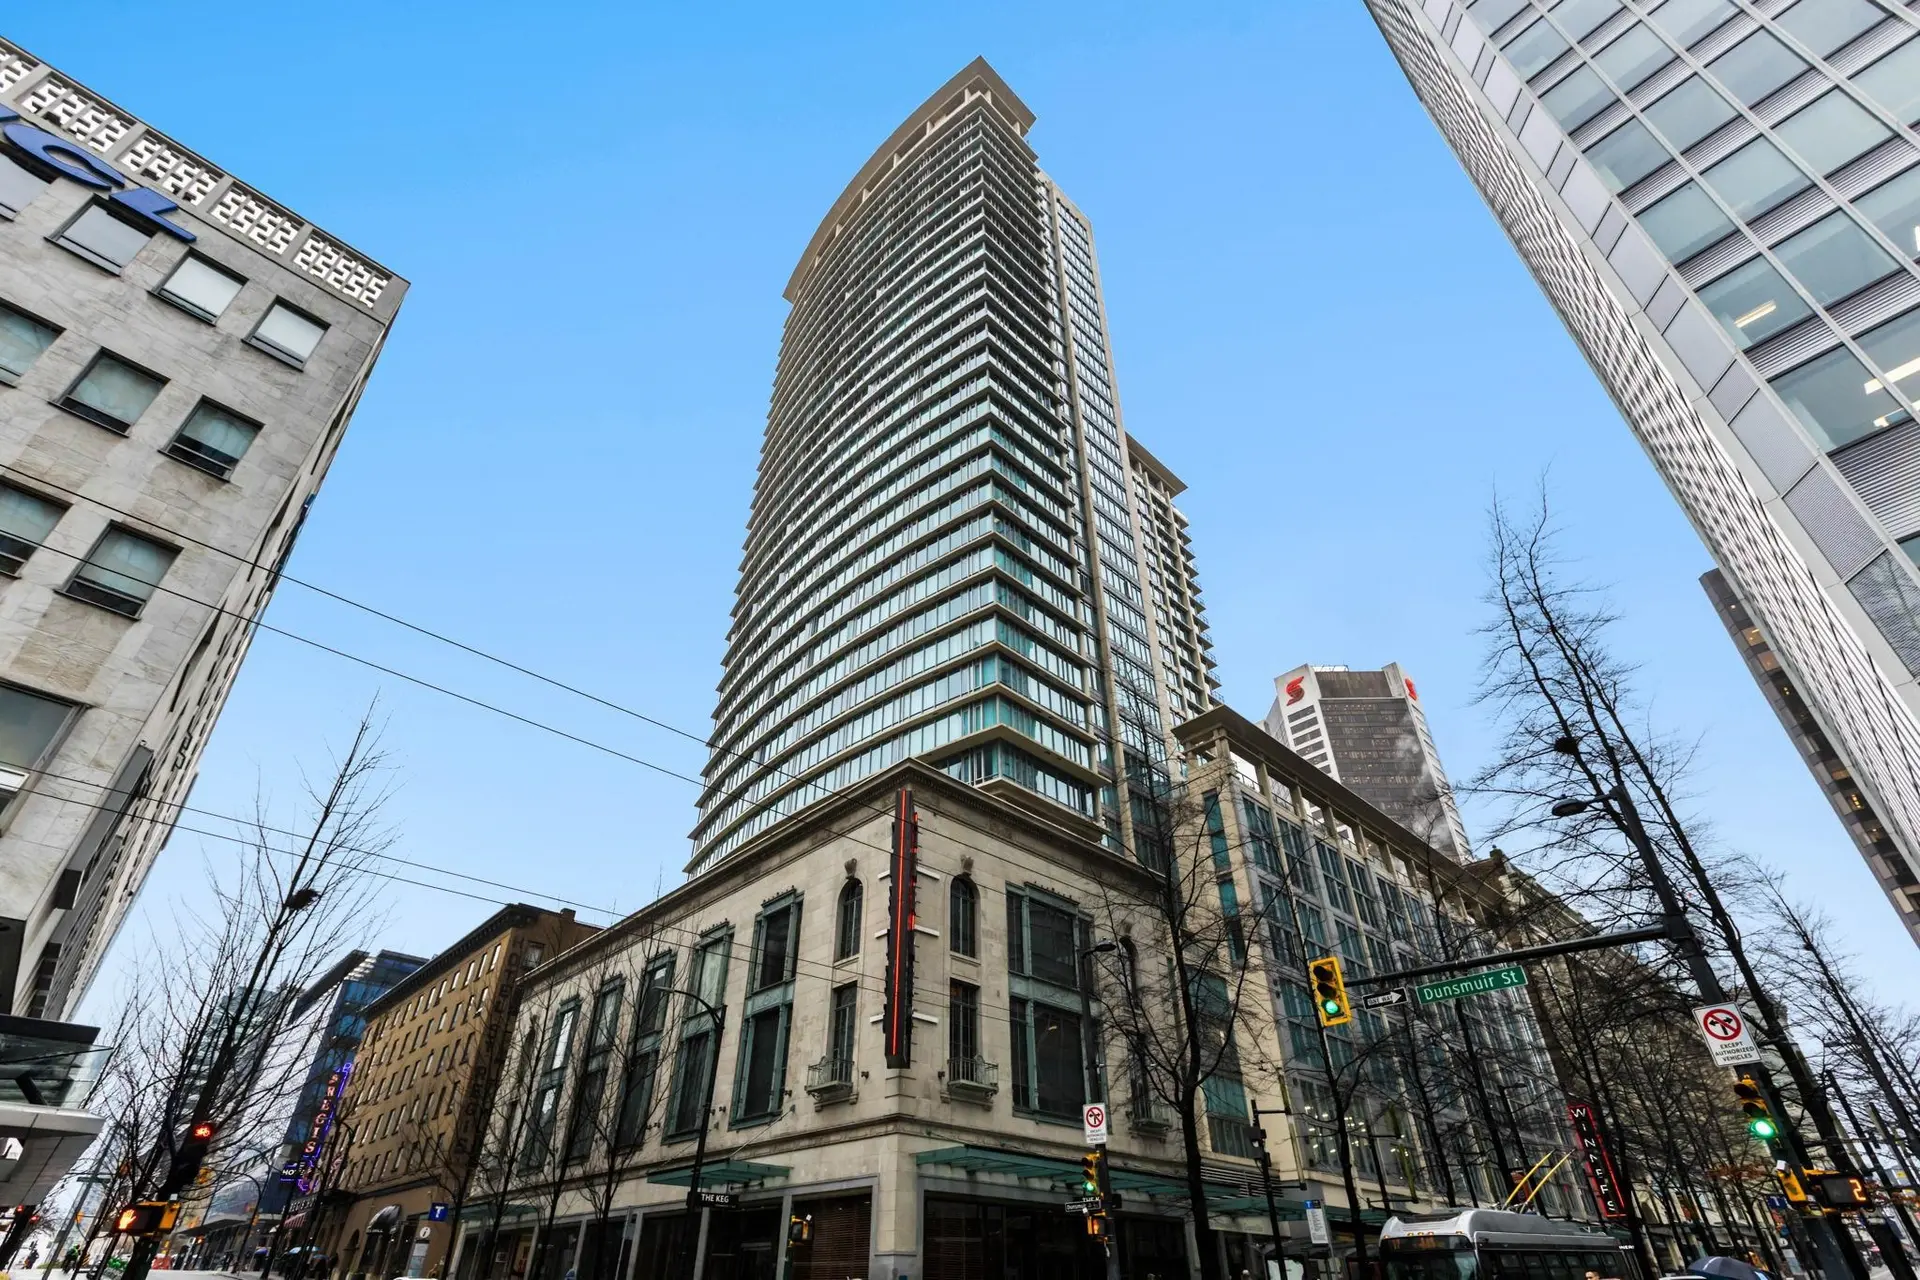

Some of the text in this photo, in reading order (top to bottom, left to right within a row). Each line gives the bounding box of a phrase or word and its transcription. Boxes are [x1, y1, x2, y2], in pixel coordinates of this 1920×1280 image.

[1423, 969, 1519, 1001] Dunsmuir St
[1720, 1041, 1744, 1050] EXCEPT
[1715, 1046, 1755, 1057] AUTHORIZED
[1722, 1053, 1753, 1062] VEHICLES
[701, 1193, 729, 1203] THE KEG
[435, 1205, 445, 1218] T
